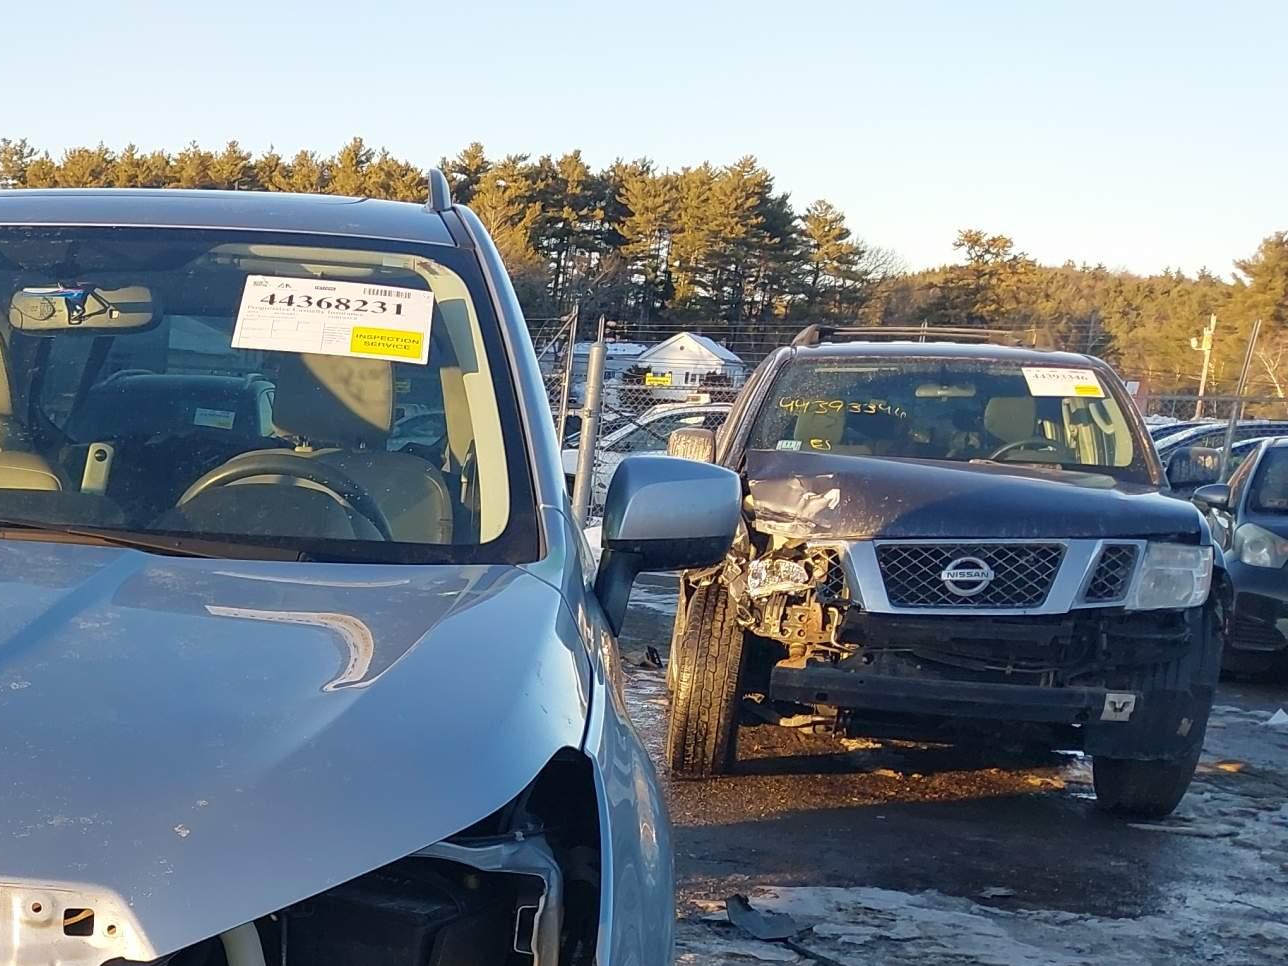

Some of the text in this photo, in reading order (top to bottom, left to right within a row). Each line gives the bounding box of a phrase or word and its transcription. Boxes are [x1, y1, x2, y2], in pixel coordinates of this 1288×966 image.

[260, 293, 404, 316] 44368231
[355, 333, 420, 345] INSPECTION
[364, 341, 410, 350] SERVICE
[947, 571, 989, 579] NISSAN
